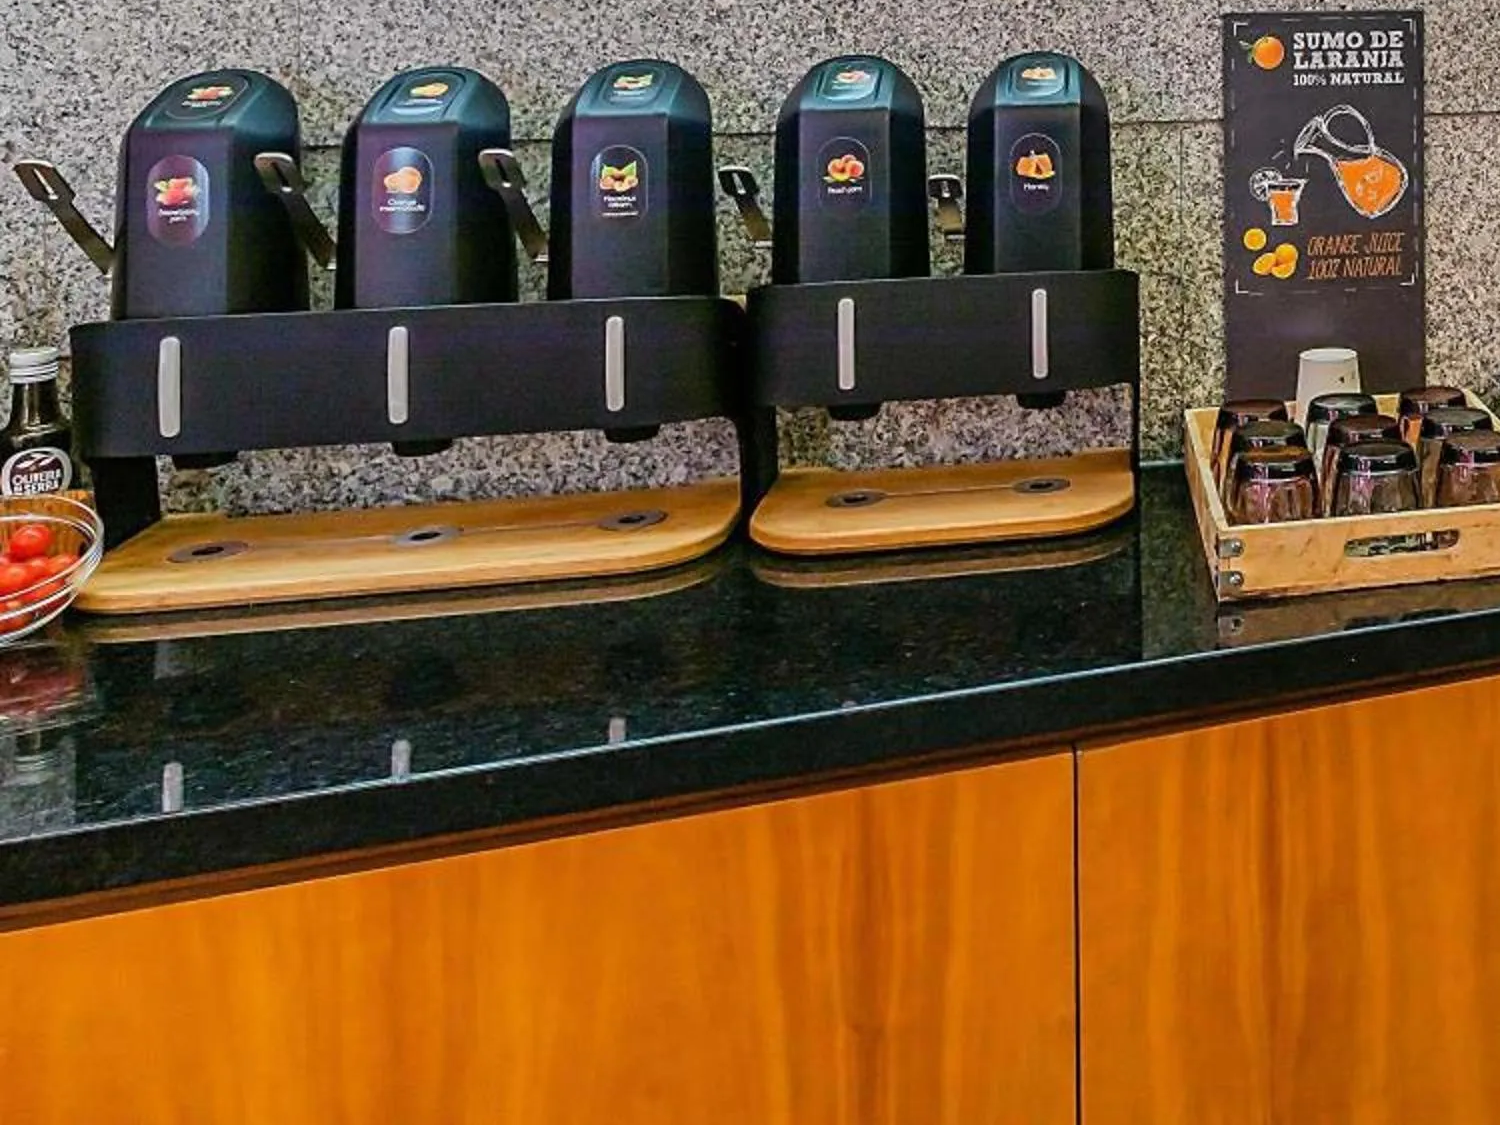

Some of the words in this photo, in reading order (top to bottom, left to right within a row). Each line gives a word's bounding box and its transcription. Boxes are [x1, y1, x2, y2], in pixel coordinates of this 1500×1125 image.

[1293, 31, 1364, 50] SUMO
[1369, 30, 1404, 49] DE
[1293, 50, 1405, 70] LARANJA
[1293, 73, 1327, 86] 100%
[1330, 71, 1405, 86] NATURAL
[1307, 234, 1363, 256] ORANGE
[1363, 232, 1405, 254] JUICE
[1306, 258, 1341, 280] 100%
[1342, 255, 1402, 278] NATURAL
